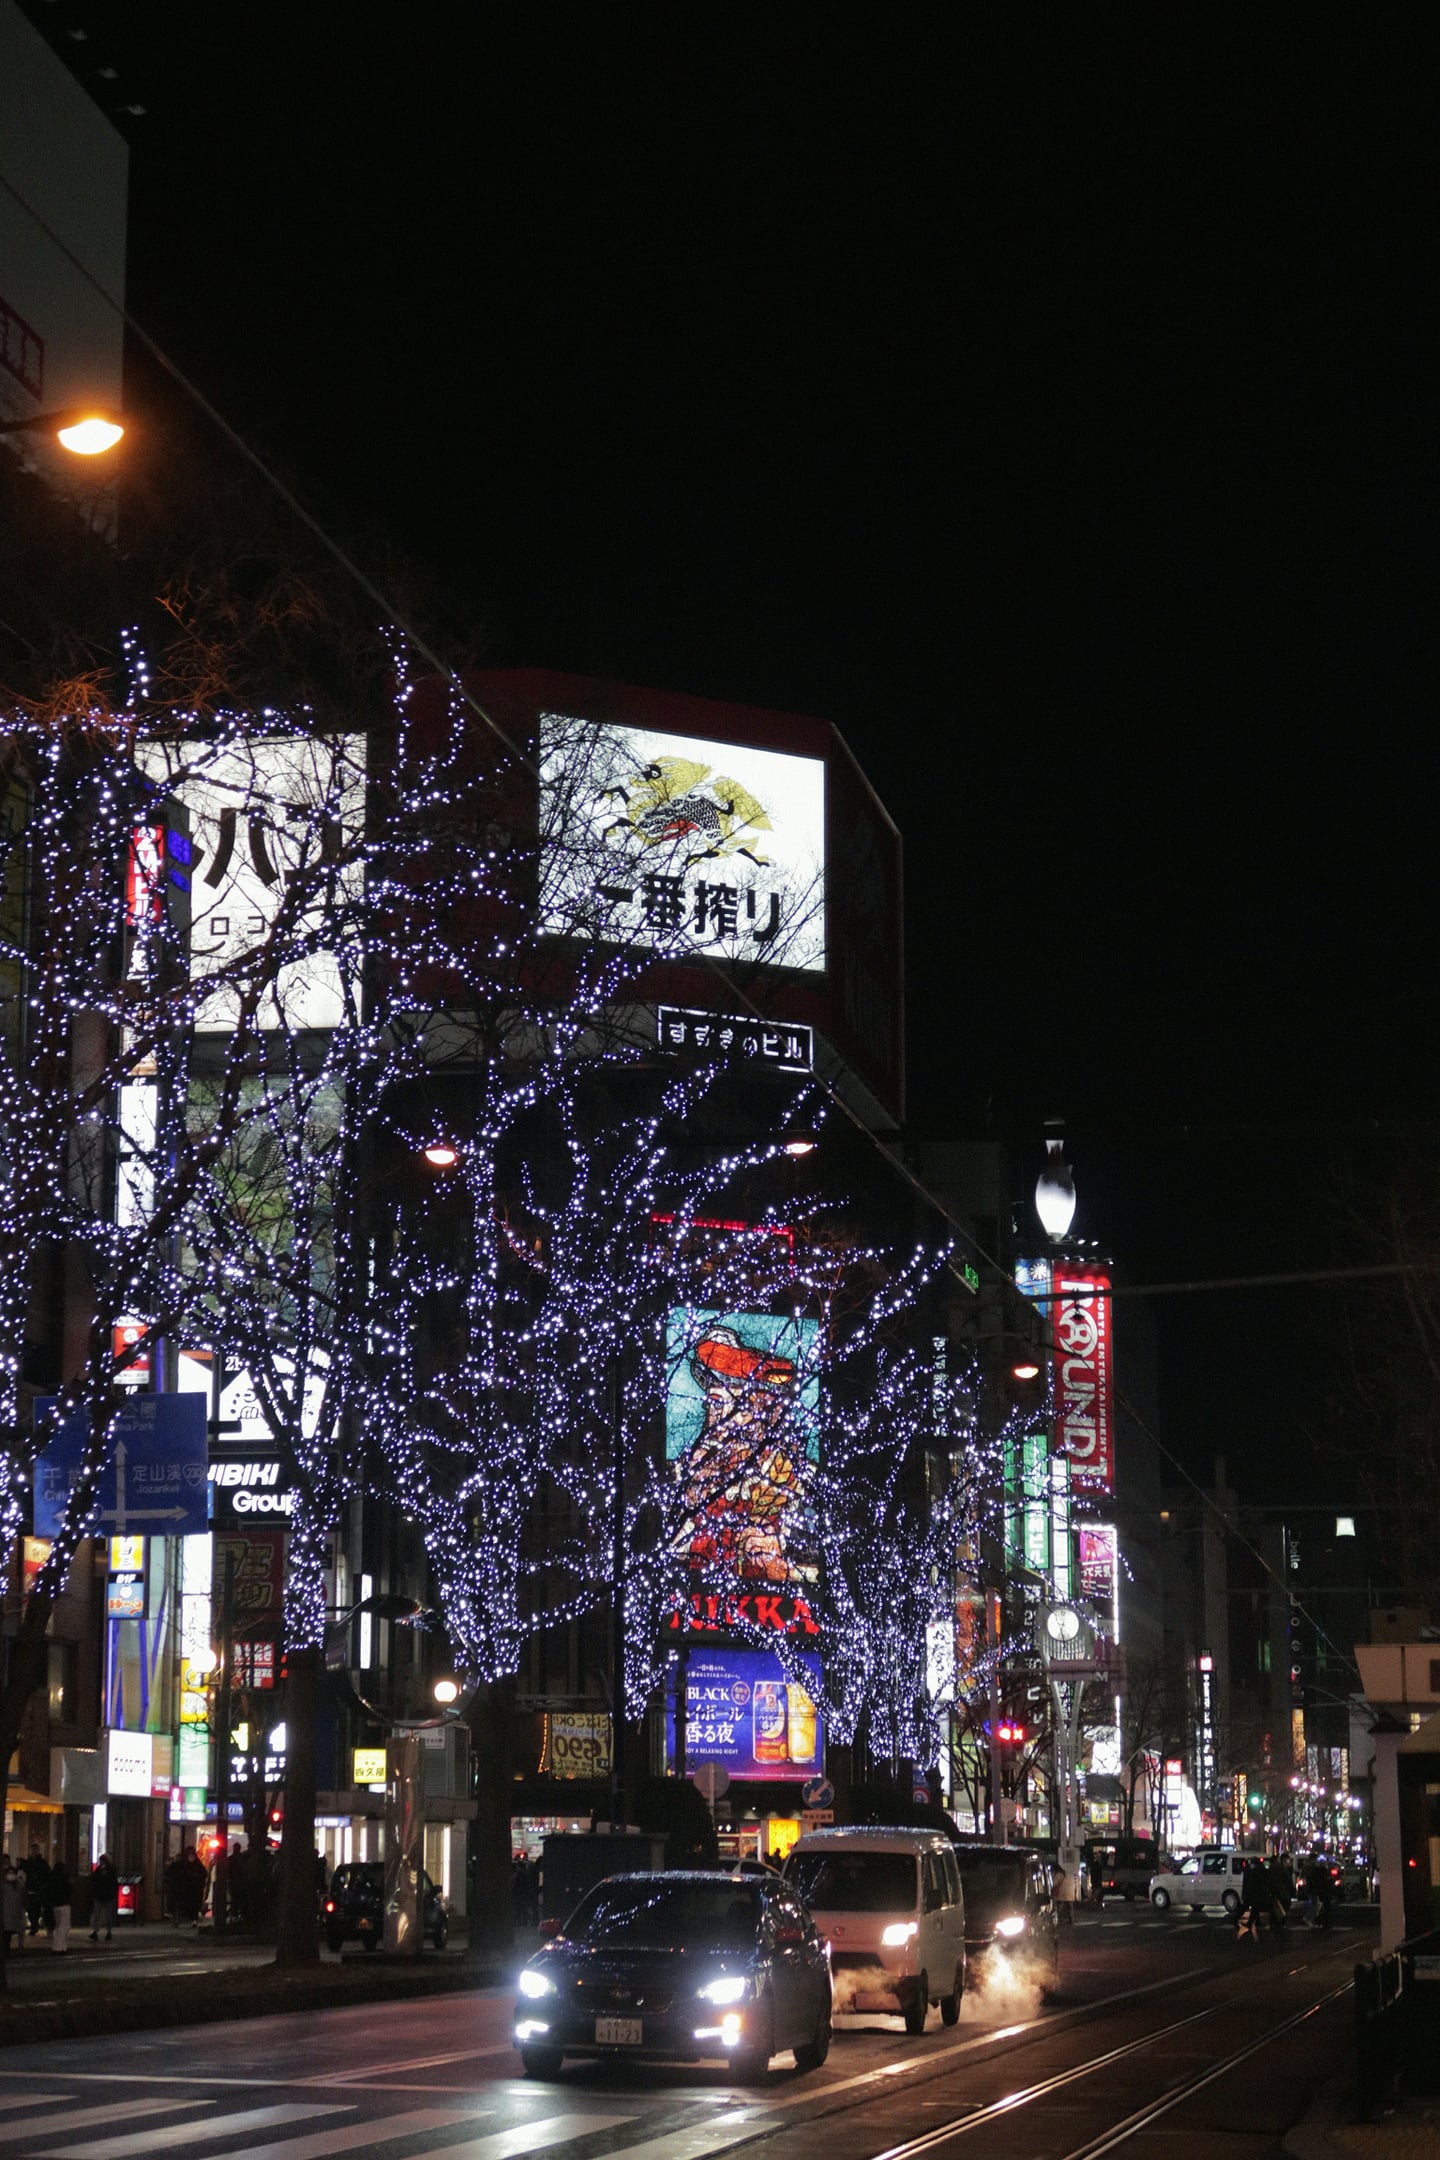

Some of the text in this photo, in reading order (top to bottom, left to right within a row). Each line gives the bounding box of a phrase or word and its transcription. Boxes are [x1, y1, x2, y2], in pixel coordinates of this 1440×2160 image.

[600, 874, 780, 942] 一番搾り
[1059, 1279, 1108, 1476] ROUND1
[132, 1466, 181, 1483] 定山渓
[669, 1593, 821, 1634] NIKKA
[688, 1687, 730, 1701] BLACK
[687, 1722, 736, 1744] 香る夜
